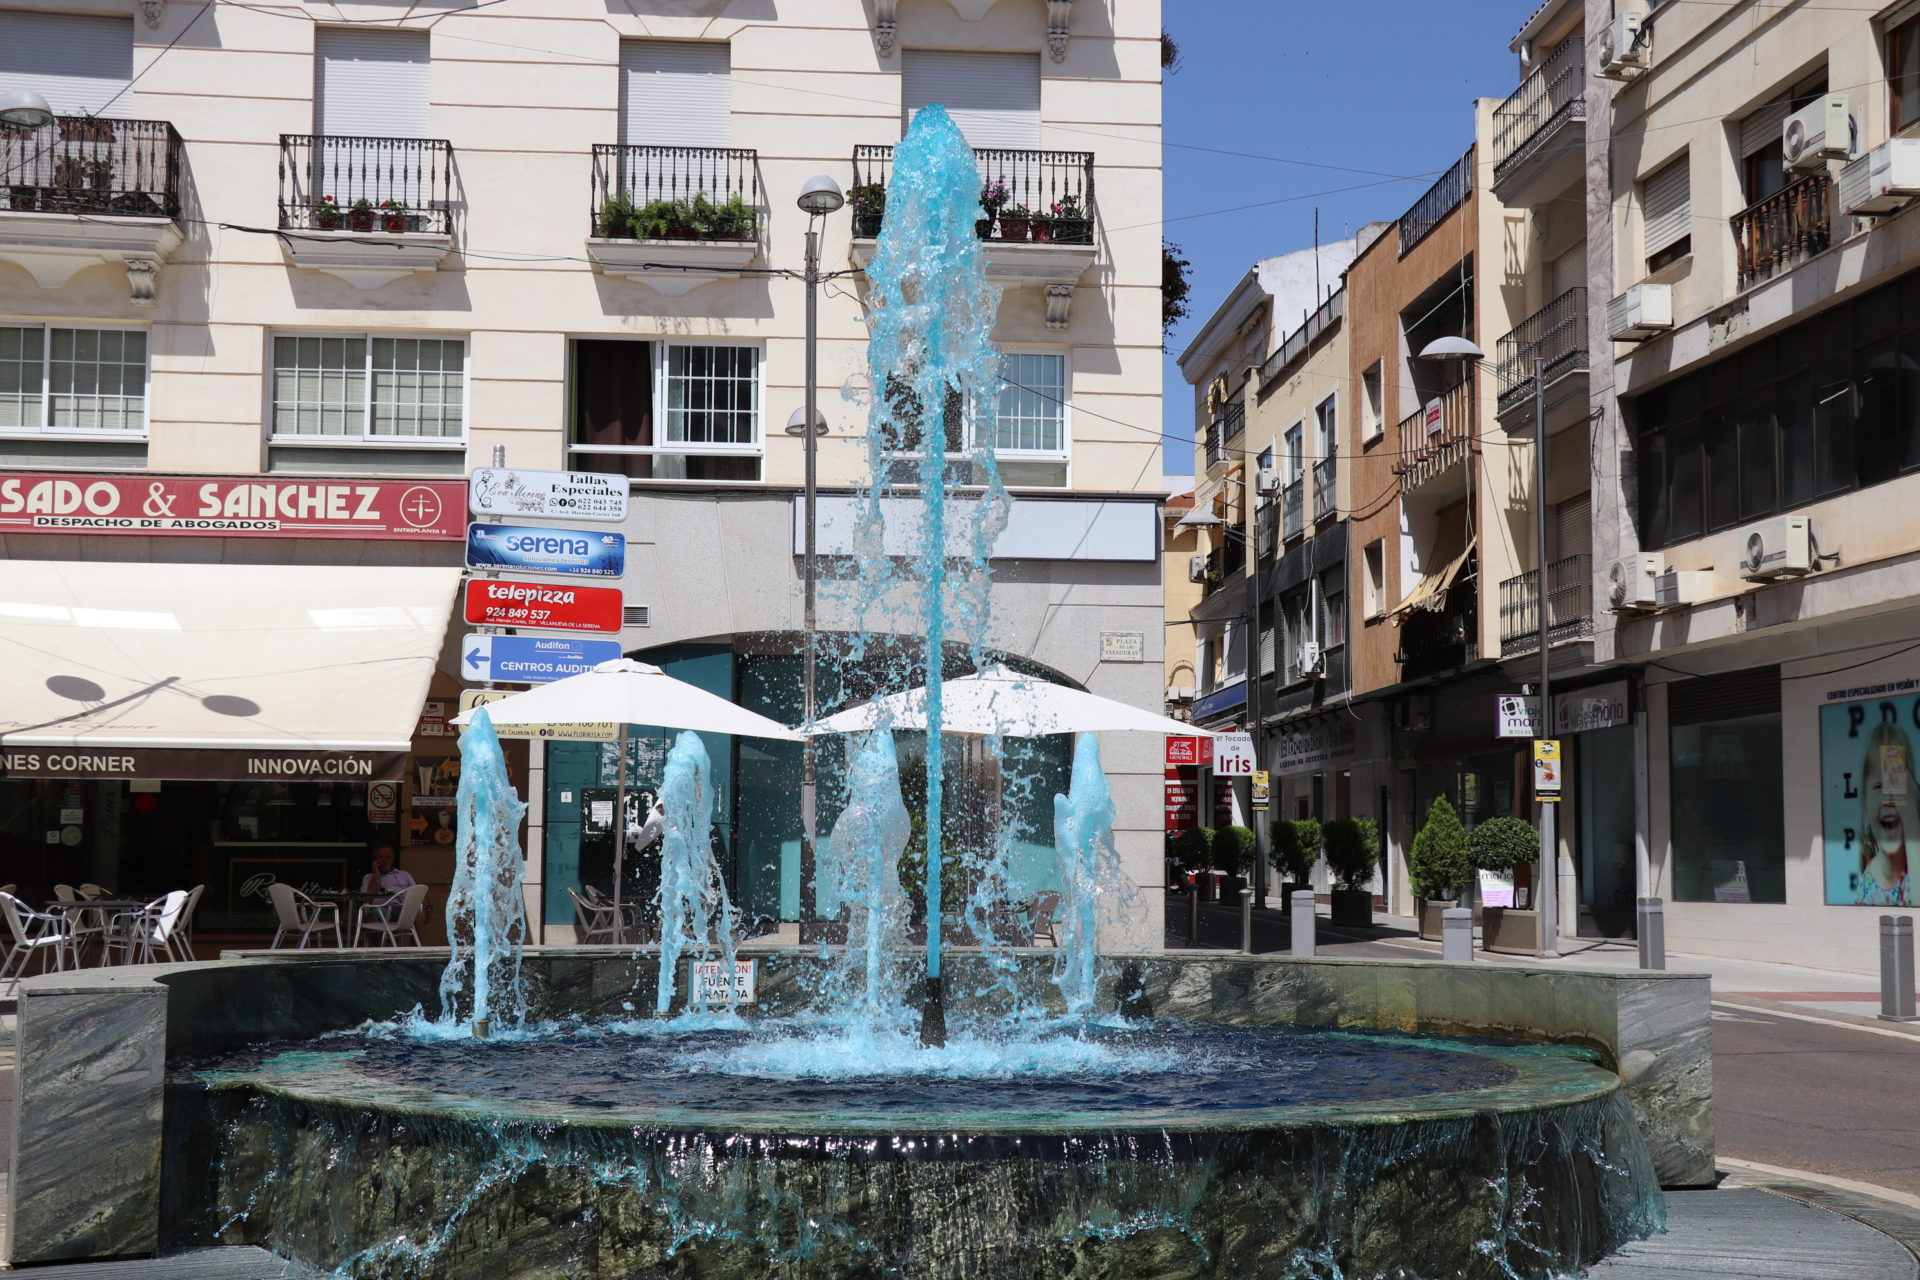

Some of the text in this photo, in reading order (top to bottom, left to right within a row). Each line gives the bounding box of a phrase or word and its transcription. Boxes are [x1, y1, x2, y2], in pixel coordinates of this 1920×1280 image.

[567, 475, 608, 485] Tallas
[551, 484, 623, 497] Especiales
[1, 478, 381, 520] SADO & SANCHEZ
[37, 518, 277, 530] DESPACHO DE ABOGADOS
[506, 535, 589, 555] serena
[476, 563, 557, 572] www.serenasoluciones.com
[488, 584, 575, 606] telepizza
[486, 607, 551, 620] 924 849 537
[535, 641, 570, 650] Audifon
[500, 661, 553, 672] CENTROS
[47, 755, 136, 772] CORNER
[248, 755, 372, 775] INNOVACIÓN
[1220, 755, 1251, 773] Iris
